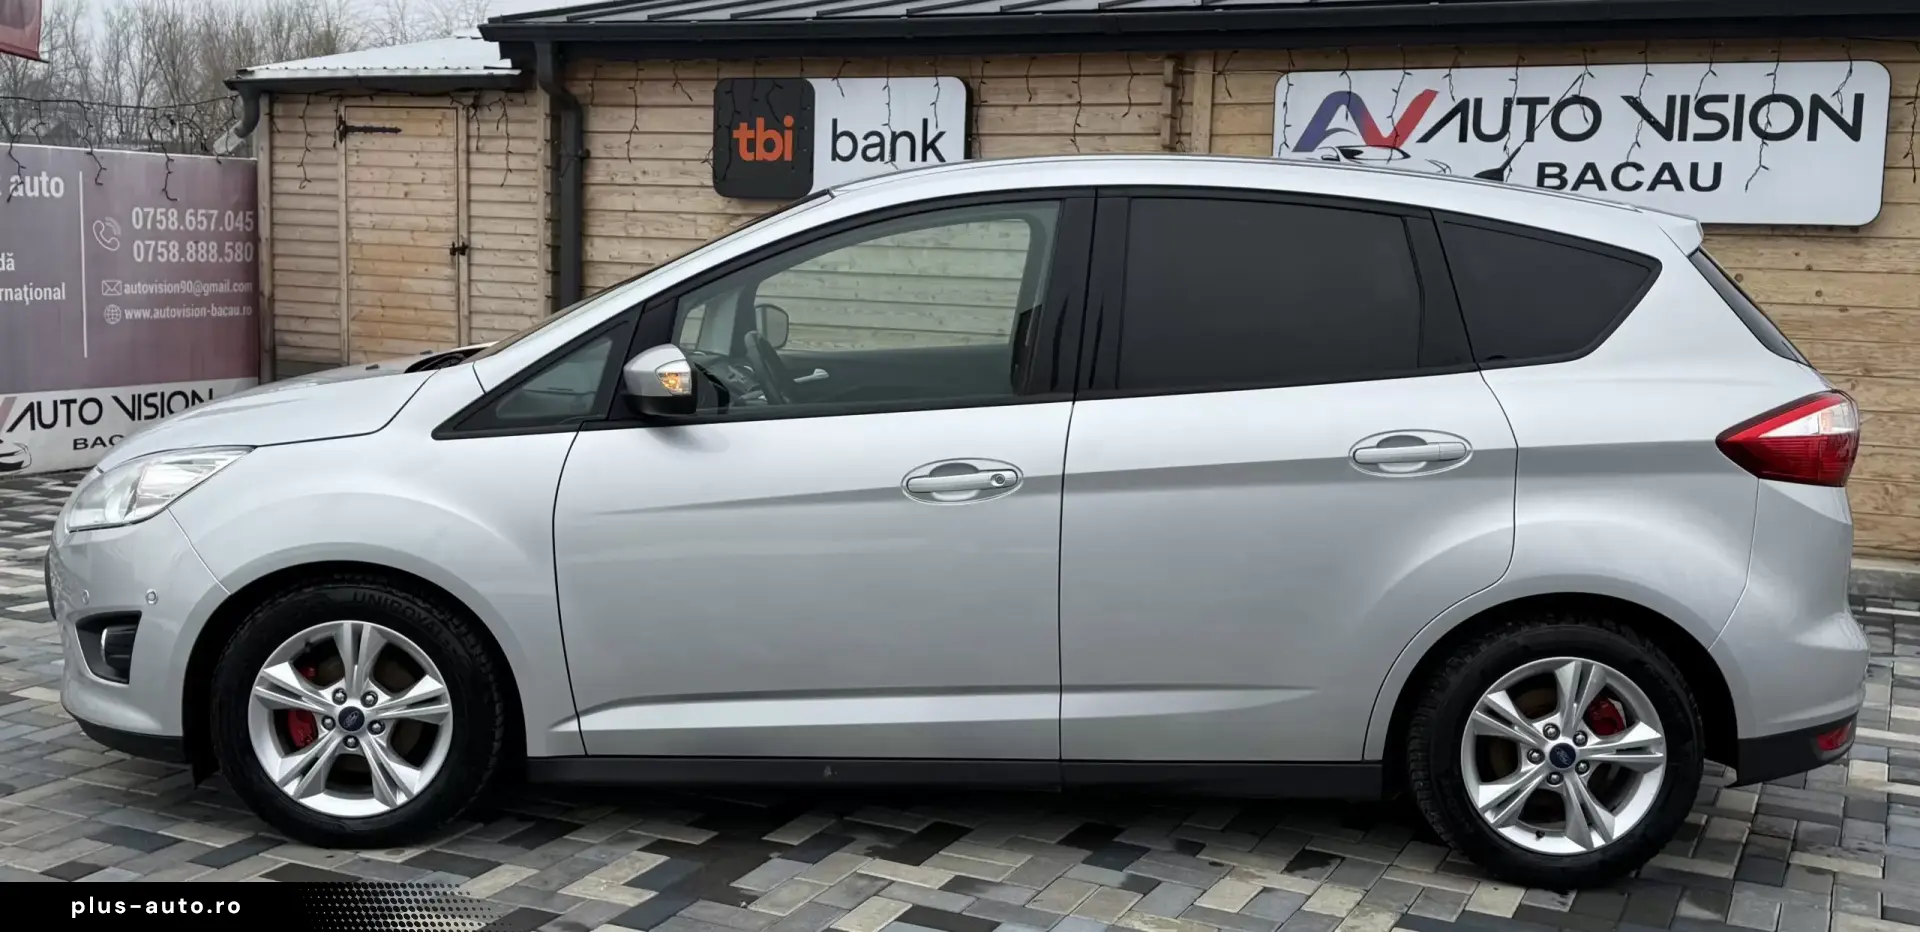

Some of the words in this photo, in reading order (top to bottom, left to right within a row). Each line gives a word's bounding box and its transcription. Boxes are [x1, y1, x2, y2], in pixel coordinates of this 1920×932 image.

[1415, 94, 1602, 143] AUTO
[1620, 92, 1864, 142] VISION
[732, 115, 795, 161] tbi
[830, 118, 947, 162] bank
[9, 171, 65, 198] auto
[1536, 160, 1723, 192] BACAU
[131, 206, 254, 232] 0758.657.045
[132, 239, 254, 263] 0758.888.580
[123, 279, 253, 297] autovision90@gmail.com
[124, 302, 253, 321] www.autovision-bacau.ro
[6, 397, 104, 433] AUTO
